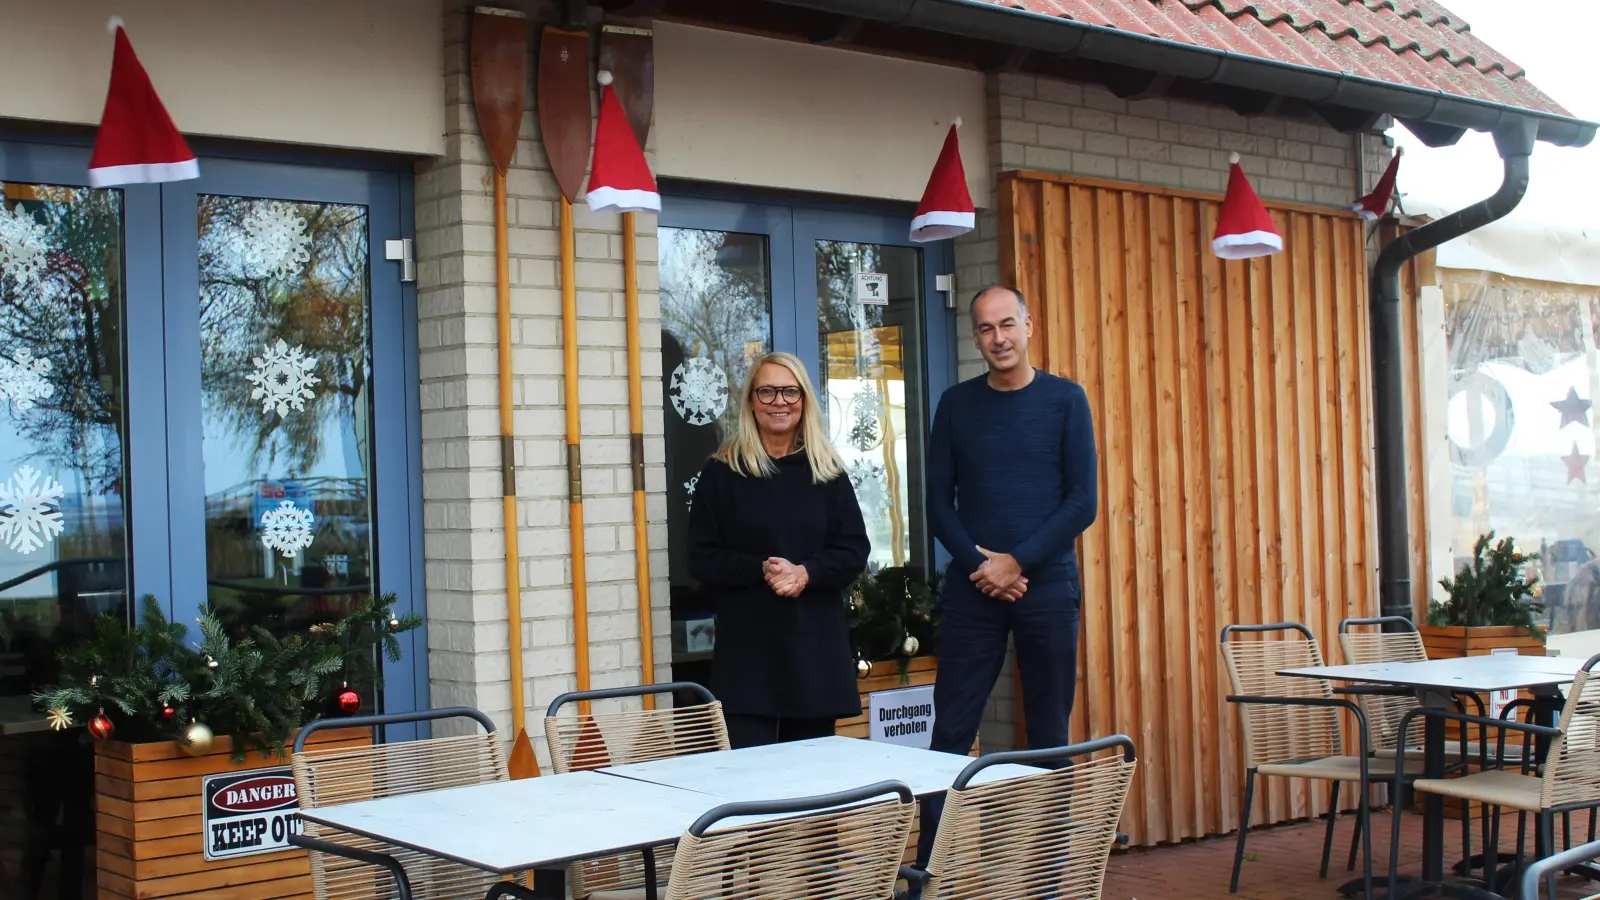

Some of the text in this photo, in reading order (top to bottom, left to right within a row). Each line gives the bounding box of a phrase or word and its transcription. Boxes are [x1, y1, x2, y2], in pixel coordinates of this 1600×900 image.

[879, 704, 932, 721] Durchgang
[884, 721, 927, 737] verboten
[226, 783, 296, 805] DANGER
[211, 813, 302, 852] KEEP OU
